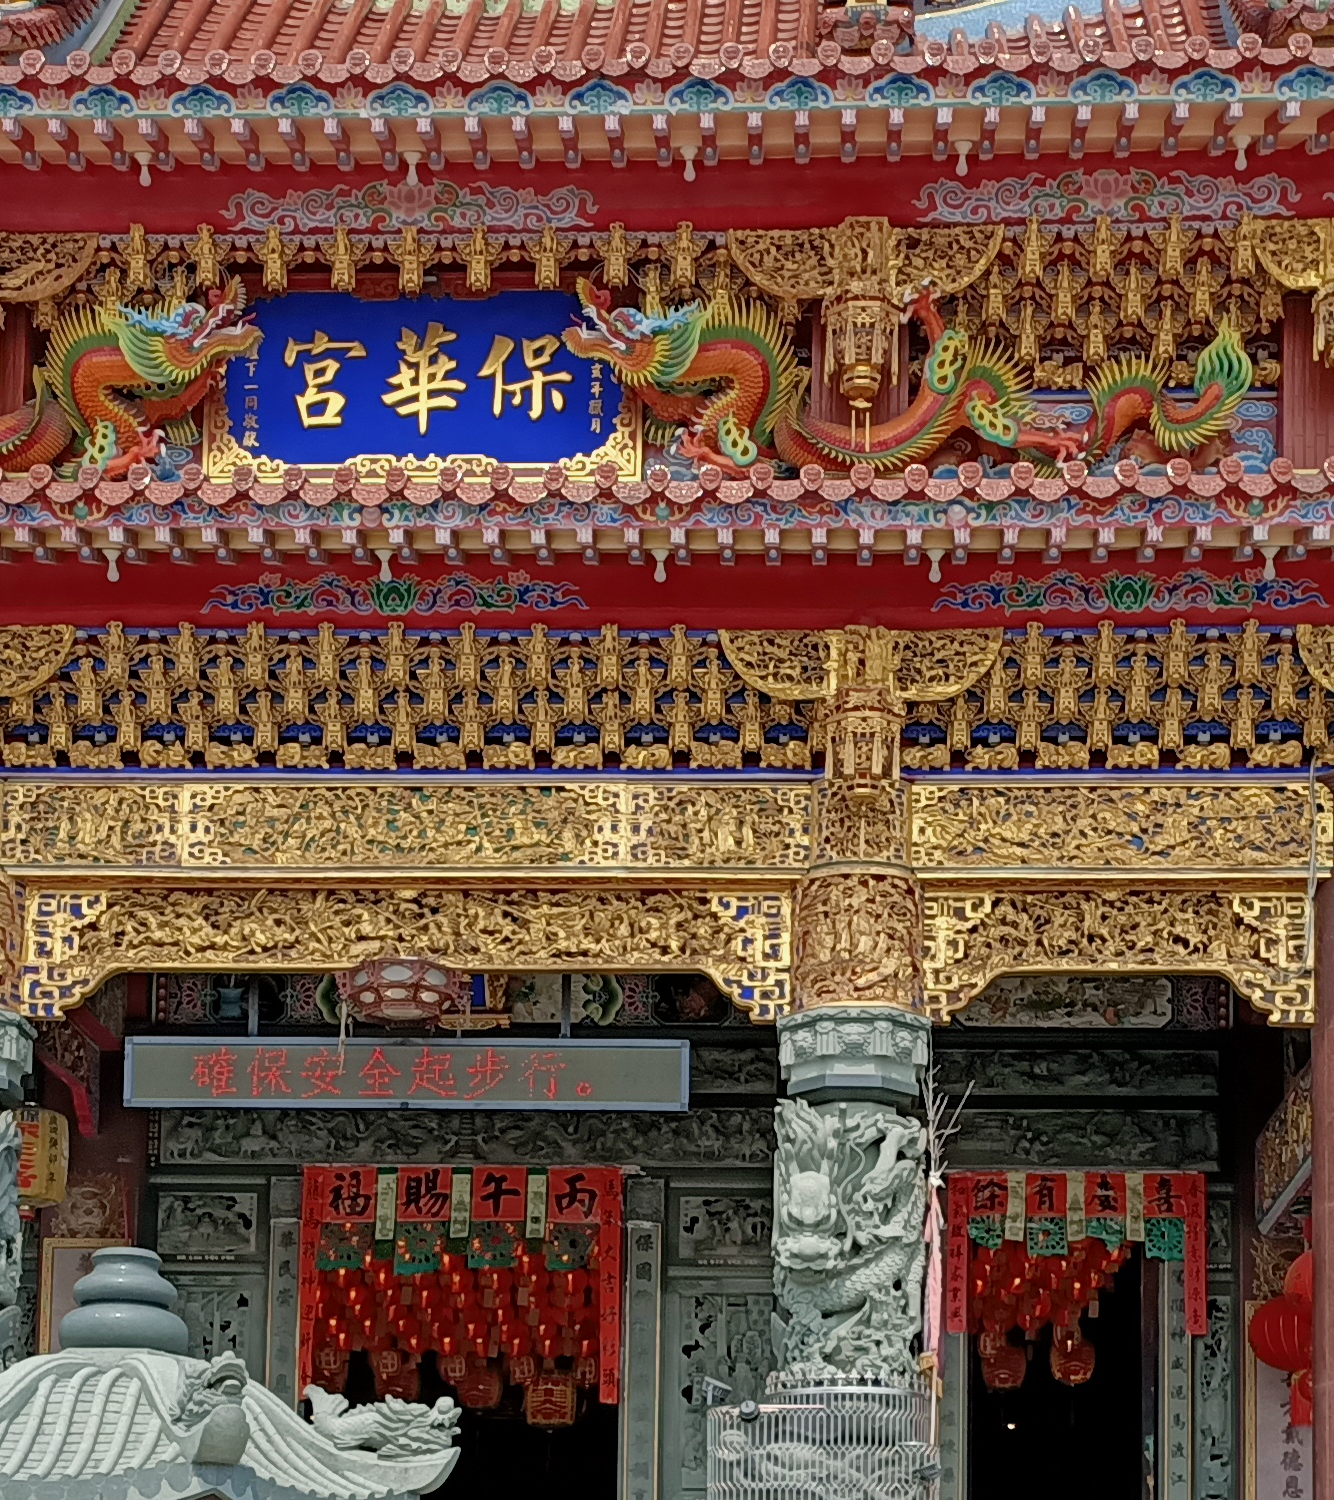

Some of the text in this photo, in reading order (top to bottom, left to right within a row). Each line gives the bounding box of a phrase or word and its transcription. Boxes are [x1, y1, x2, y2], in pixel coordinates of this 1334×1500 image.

[283, 321, 572, 435] 保華宮
[588, 356, 604, 434] 亥年臘月
